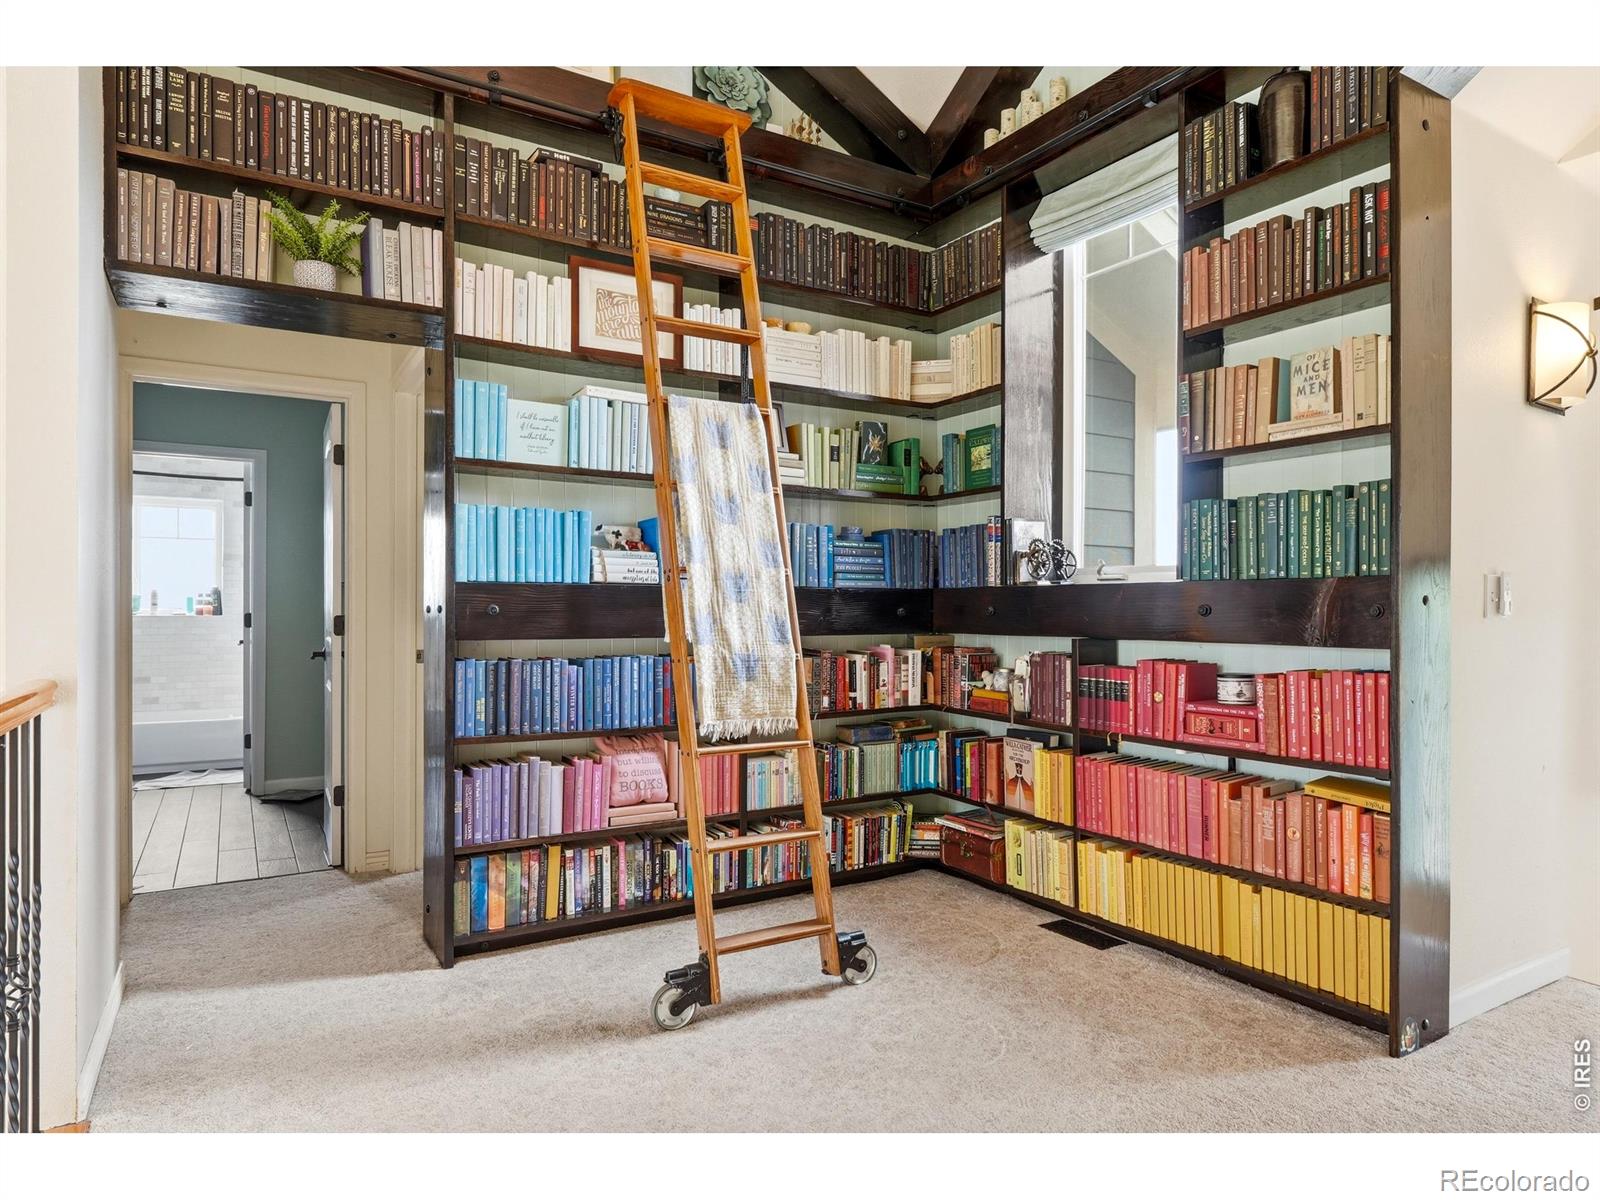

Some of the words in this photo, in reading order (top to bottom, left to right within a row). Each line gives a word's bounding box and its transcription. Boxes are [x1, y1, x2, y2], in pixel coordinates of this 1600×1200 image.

[384, 146, 389, 154] WE
[130, 176, 139, 207] ARTEMIS
[1365, 193, 1373, 207] ASK
[1365, 209, 1373, 224] NOT
[385, 261, 393, 286] HOUSE
[1293, 359, 1330, 378] MICE
[1304, 374, 1320, 382] AND
[1296, 380, 1328, 397] MEN
[616, 758, 632, 766] but
[618, 770, 628, 778] to
[618, 778, 664, 793] BOOKS
